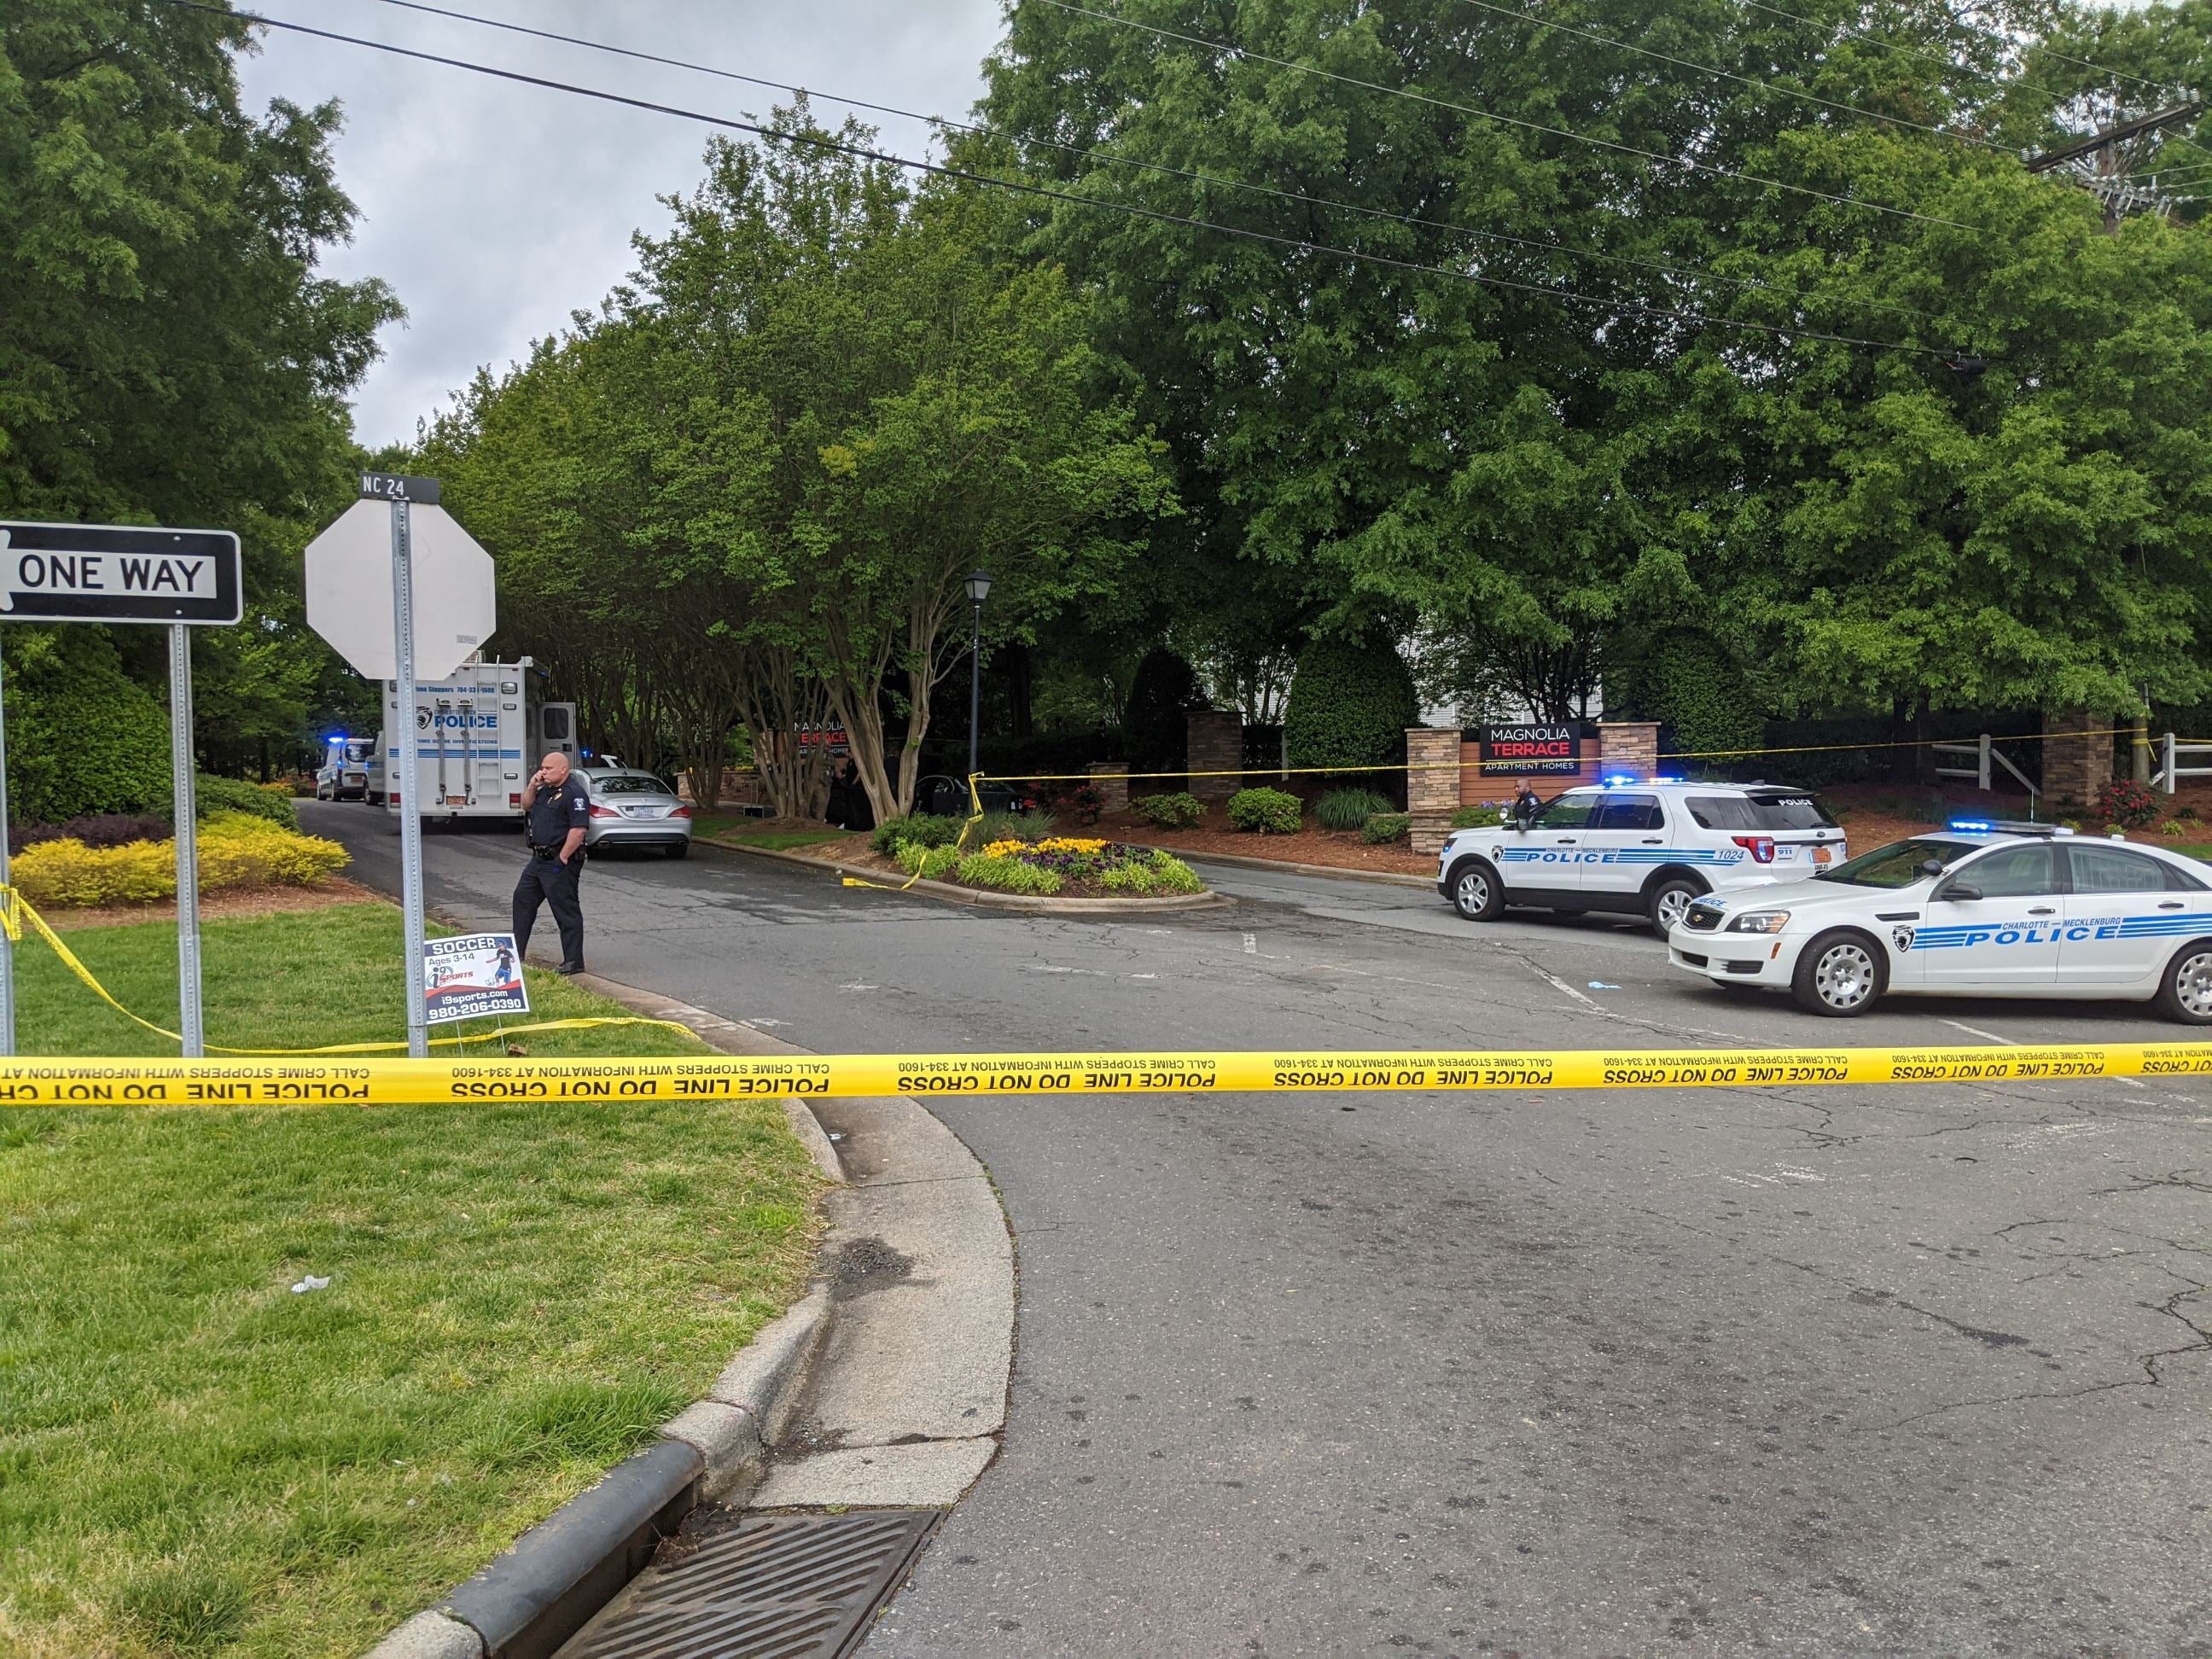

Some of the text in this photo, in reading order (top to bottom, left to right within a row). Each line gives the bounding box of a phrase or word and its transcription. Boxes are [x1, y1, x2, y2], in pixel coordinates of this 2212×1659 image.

[363, 476, 405, 496] NC 24
[20, 554, 204, 592] ONE WAY
[434, 715, 498, 728] POLICE
[1491, 728, 1570, 741] MAGNOLIA
[1491, 742, 1570, 756] TERRACE
[1485, 762, 1539, 771] APARTMENT
[1525, 853, 1617, 864] POLICE
[1718, 851, 1744, 860] 1024
[2002, 920, 2049, 930] CHARLOTTE
[2063, 917, 2122, 928] MECKLENBURG
[1965, 926, 2120, 946] POLICE
[432, 938, 496, 955] SOCCER
[428, 952, 475, 967] Ages 3-14
[439, 971, 474, 983] SPORTS
[441, 990, 509, 1005] i9sports.com
[429, 998, 521, 1020] 980-206-0390
[899, 1060, 1215, 1073] CALL CRIME STOPPERS WITH INFORMATION AT 334-1600
[1274, 1058, 1552, 1069] CALL CRIME STOPPERS WITH INFORMATION AT 334-1600
[1604, 1056, 1848, 1067] CALL CRIME STOPPERS WITH INFORMATION AT 334-1600
[2141, 1061, 2190, 1072] CROSS
[2, 1068, 370, 1080] CALL CRIME STOPPERS WITH INFORMATION AT
[452, 1064, 830, 1079] CALL CRIME STOPPERS WITH INFORMATION AT 334-1600
[1604, 1068, 1848, 1083] POLICE LINE DO NOT CROSS
[1891, 1062, 2104, 1078] POLICE LINE DO NOT CROSS
[898, 1073, 1215, 1091] POLICE LINE DO NOT CROSS
[1274, 1071, 1552, 1086] POLICE LINE DO NOT CROSS
[51, 1085, 113, 1100] NOT
[123, 1084, 166, 1100] DO
[186, 1084, 252, 1100] LINE
[263, 1084, 369, 1099] POLICE
[451, 1079, 829, 1097] POLICE LINE DO NOT CROSS
